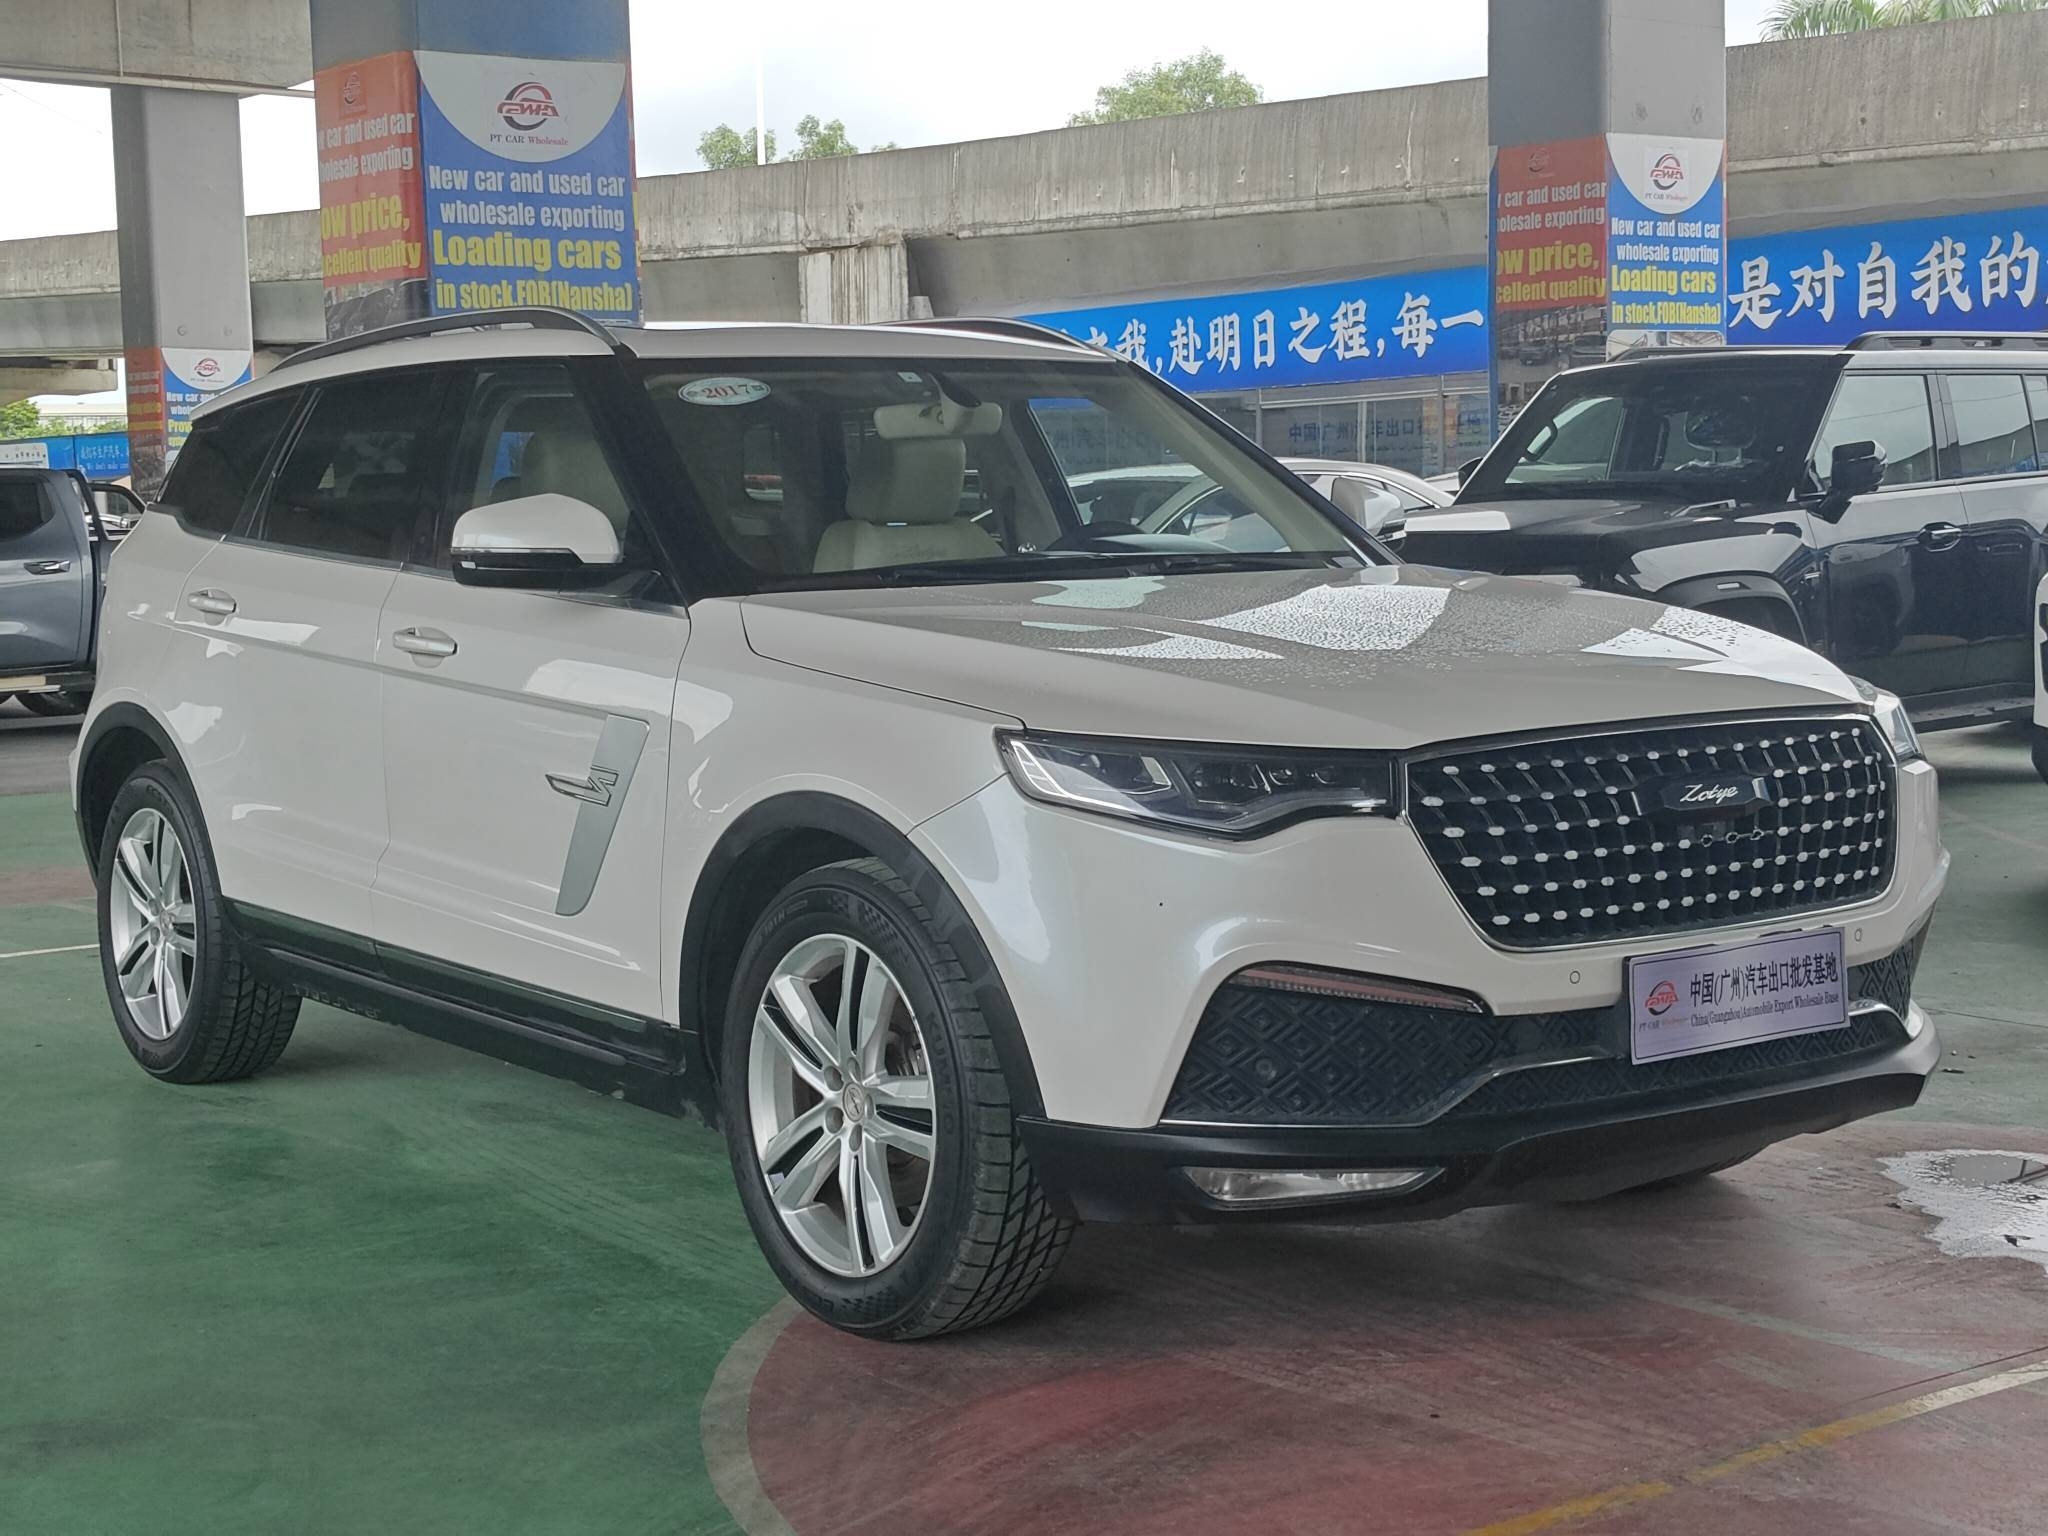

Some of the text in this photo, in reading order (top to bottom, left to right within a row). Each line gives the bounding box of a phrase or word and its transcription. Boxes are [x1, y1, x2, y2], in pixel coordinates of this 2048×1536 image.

[364, 112, 388, 140] used
[389, 112, 415, 135] car
[489, 134, 569, 146] PT CAR Wholesale
[360, 144, 414, 176] exporting
[428, 165, 626, 197] New car and used car
[1504, 190, 1525, 208] car
[1526, 185, 1549, 205] and
[1551, 182, 1581, 202] used
[1584, 181, 1607, 199] car
[350, 192, 411, 240] price,
[440, 200, 625, 232] wholesale exporting
[1544, 205, 1606, 229] exporting
[1611, 217, 1721, 239] New car and used car
[368, 239, 422, 273] quality
[432, 229, 622, 272] Loading cars
[1528, 240, 1600, 276] price,
[1617, 243, 1720, 266] wholesale exporting
[1550, 275, 1606, 302] quality
[1611, 264, 1717, 295] Loading cars
[1728, 231, 2048, 329] 是对自我的
[435, 278, 457, 310] in
[1611, 301, 1624, 324] in
[185, 392, 198, 402] car
[701, 383, 751, 399] 2017
[1680, 783, 1739, 804] Zotye
[1690, 951, 1839, 1008] 中国(广州)汽车出口批发基地
[1774, 999, 1793, 1014] Export
[1794, 993, 1824, 1009] Wholesale
